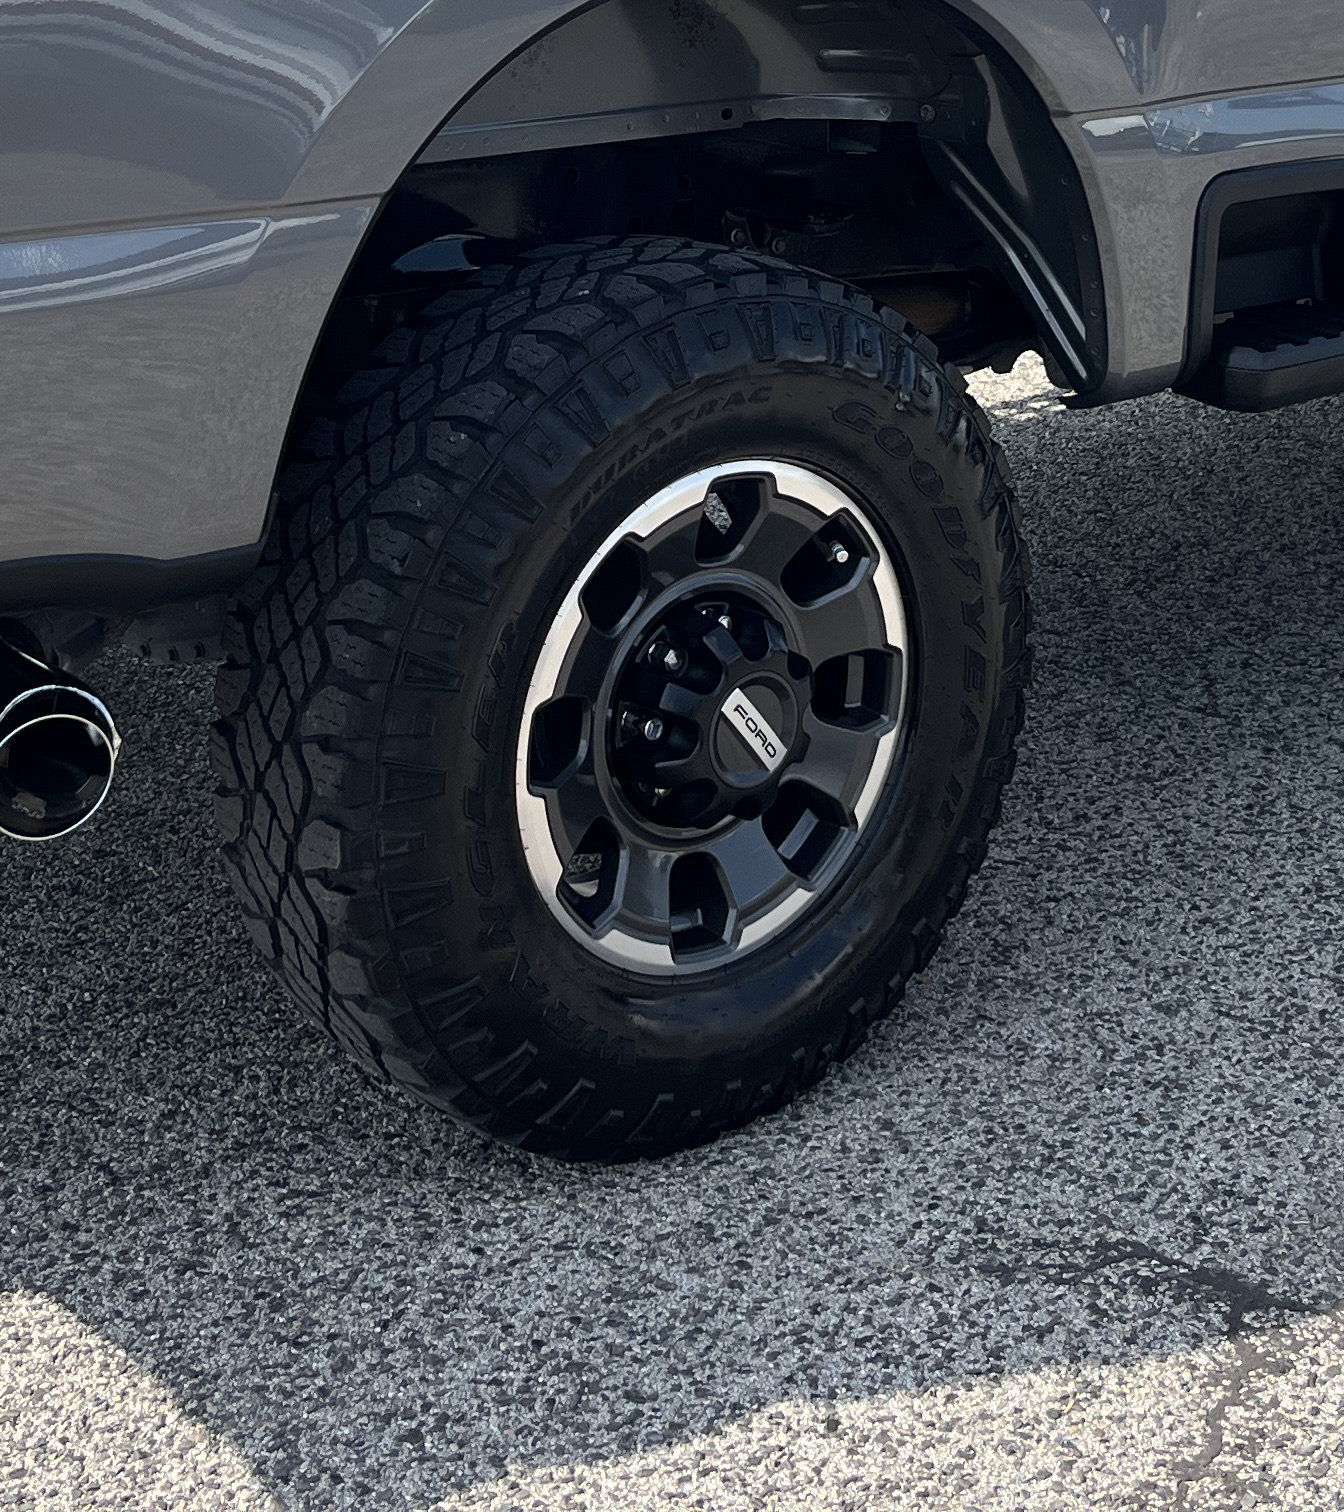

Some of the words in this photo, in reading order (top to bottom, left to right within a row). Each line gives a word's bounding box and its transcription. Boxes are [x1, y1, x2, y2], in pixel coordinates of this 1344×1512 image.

[569, 385, 774, 527] DURATRAC
[733, 703, 777, 759] FORD
[833, 401, 987, 832] GOODYEAR
[465, 620, 637, 1065] WRANGLER
